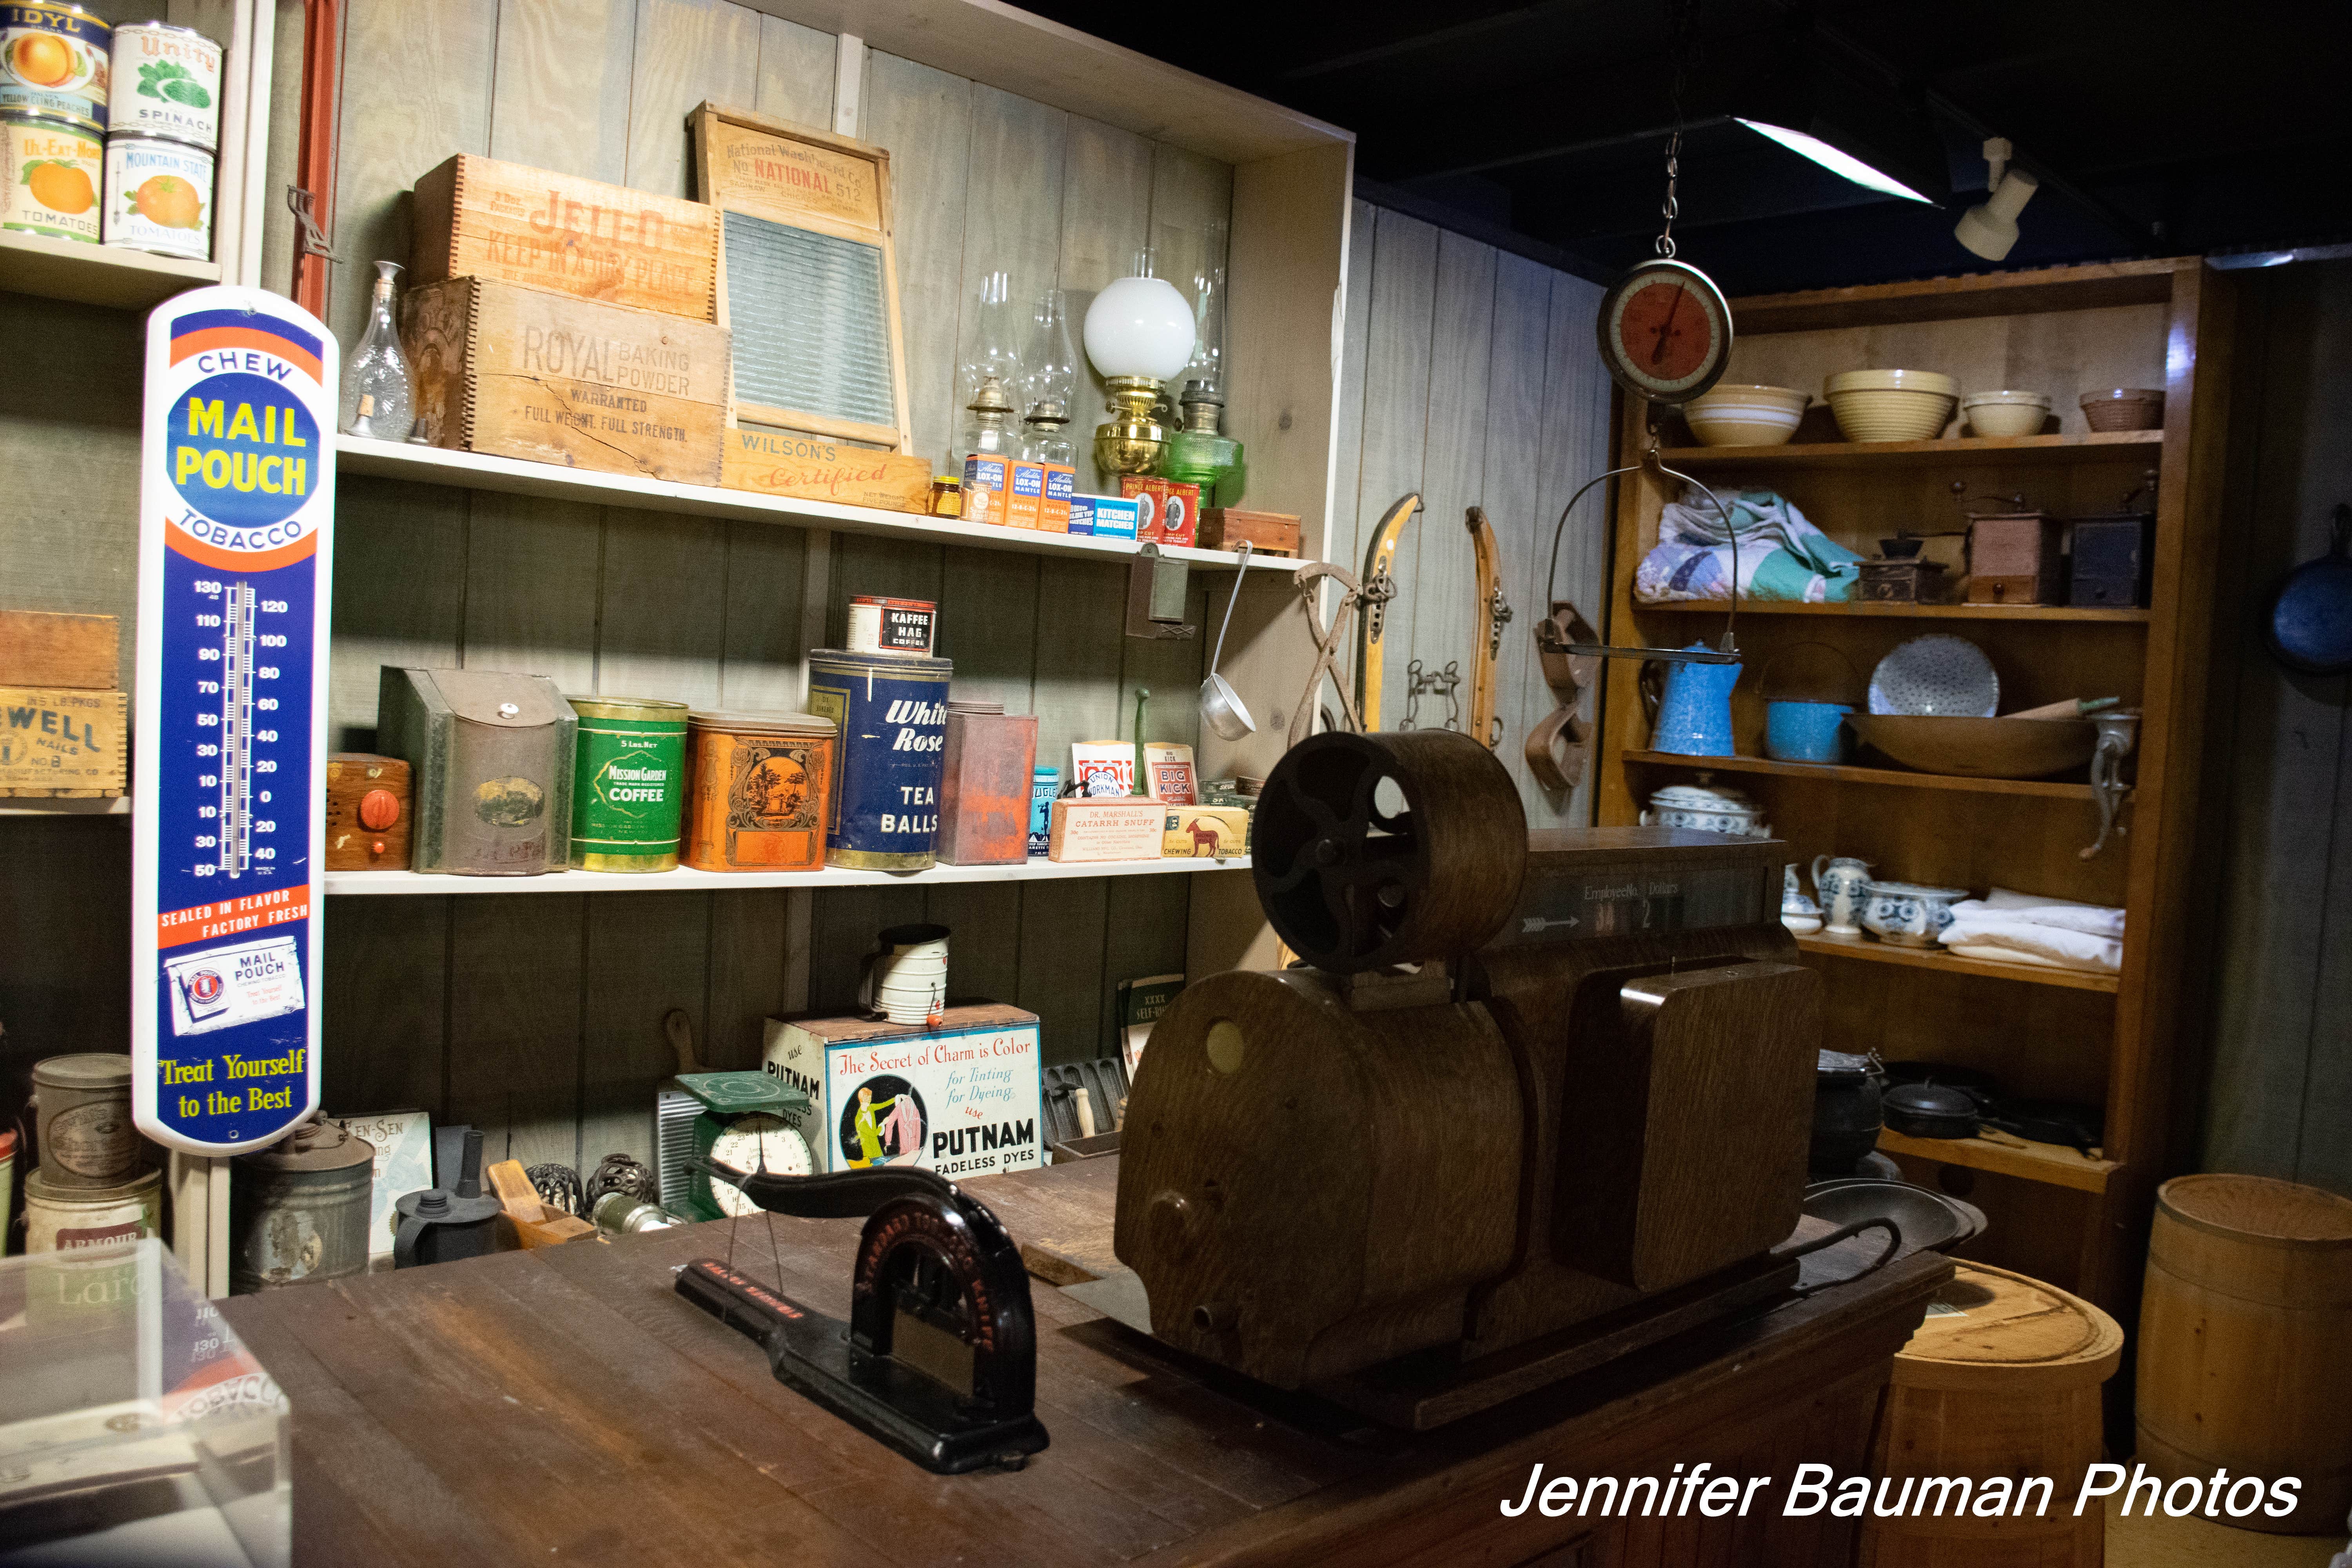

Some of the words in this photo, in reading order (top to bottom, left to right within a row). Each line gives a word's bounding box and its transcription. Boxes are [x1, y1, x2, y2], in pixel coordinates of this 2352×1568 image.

[13, 8, 80, 32] IDYL
[141, 36, 214, 73] Unity
[139, 109, 212, 133] SPINACH
[126, 152, 180, 169] MOUNTAIN
[184, 160, 207, 182] STATE
[755, 158, 832, 194] NATIONAL
[836, 183, 861, 201] 512
[22, 210, 98, 235] TOMATOES
[130, 225, 201, 246] TOMATOES
[487, 230, 541, 267] KEEP
[523, 325, 614, 384] ROYAL
[618, 341, 690, 372] BAKING
[198, 351, 292, 381] CHEW
[617, 365, 689, 396] POWDER
[571, 388, 647, 413] WARRANTED
[189, 397, 306, 448] MAIL
[525, 405, 552, 424] FULL
[601, 416, 627, 434] FULL
[741, 434, 836, 461] WILSON'S
[176, 446, 307, 496] POUCH
[977, 472, 1002, 482] LOX-ON
[770, 464, 887, 496] Certified
[1016, 478, 1041, 488] LOX-ON
[1049, 483, 1072, 492] LOX-ON
[1097, 508, 1135, 521] KITCHEN
[179, 508, 302, 550] TOBACCO
[1096, 519, 1134, 530] MATCHES
[194, 581, 222, 593] 130
[261, 601, 288, 613] 120
[196, 615, 221, 626] 110
[892, 613, 928, 625] KAFFEE
[898, 626, 922, 637] HAG
[260, 635, 287, 647] 100
[198, 648, 220, 660] 90
[259, 667, 280, 679] 80
[198, 681, 219, 693] 70
[258, 699, 279, 710] 60
[886, 698, 947, 724] White
[197, 714, 218, 726] 50
[257, 731, 278, 742] 40
[893, 728, 942, 752] Rose
[36, 737, 78, 755] NAILS
[197, 745, 218, 756] 30
[257, 761, 278, 773] 20
[199, 776, 218, 787] 10
[1091, 774, 1113, 783] UNION
[1161, 771, 1185, 782] BIG
[260, 791, 271, 802] 0
[609, 788, 664, 802] COFFEE
[901, 786, 934, 805] TEA
[1033, 788, 1057, 798] UGLE
[1160, 783, 1191, 794] KICK
[199, 806, 217, 818] 10
[256, 822, 276, 832] 20
[881, 814, 938, 833] BALLS
[196, 836, 216, 848] 30
[255, 848, 276, 859] 40
[194, 865, 216, 877] 50
[162, 907, 212, 927] SEALED
[220, 901, 232, 915] IN
[240, 890, 290, 912] FLAVOR
[203, 915, 259, 938] FACTORY
[268, 905, 307, 925] FRESH
[240, 952, 276, 968] MAIL
[235, 961, 285, 981] POUCH
[238, 979, 260, 987] CHEWING
[261, 974, 286, 983] TOBACCO
[788, 1045, 802, 1060] use
[837, 1054, 866, 1076] The
[870, 1051, 913, 1073] Secret
[918, 1046, 931, 1065] of
[935, 1044, 974, 1064] Charm
[979, 1042, 989, 1058] is
[993, 1037, 1031, 1057] Color
[161, 1059, 214, 1085] Treat
[223, 1049, 306, 1079] Yourself
[768, 1060, 820, 1100] PUTNAM
[946, 1072, 966, 1091] for
[969, 1067, 1014, 1083] Tinting
[179, 1095, 199, 1118] to
[207, 1091, 241, 1115] the
[248, 1085, 292, 1111] Best
[946, 1090, 965, 1109] for
[968, 1085, 1014, 1104] Dyeing
[965, 1106, 983, 1120] use
[933, 1118, 1034, 1159] PUTNAM
[935, 1157, 996, 1175] FADELESS
[1004, 1149, 1034, 1164] DYES
[64, 1232, 137, 1250] ARMOUR
